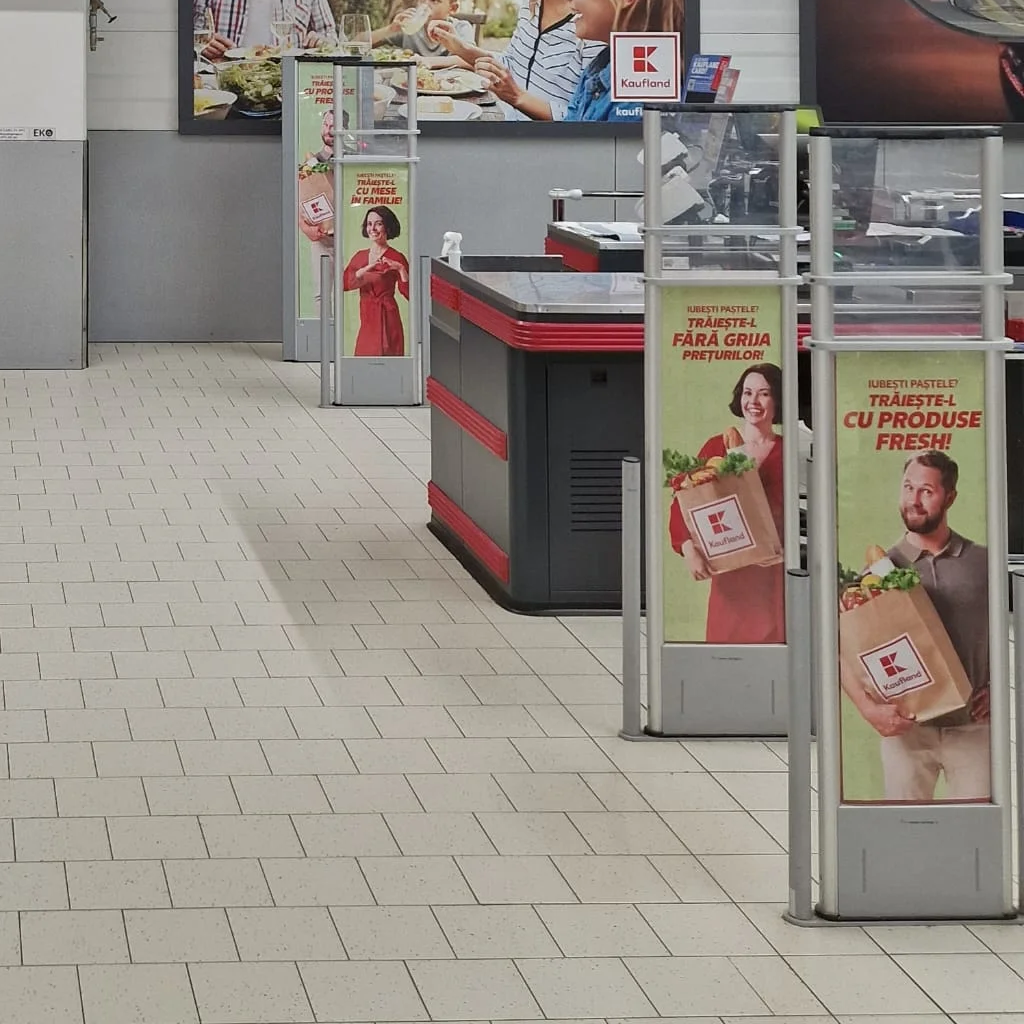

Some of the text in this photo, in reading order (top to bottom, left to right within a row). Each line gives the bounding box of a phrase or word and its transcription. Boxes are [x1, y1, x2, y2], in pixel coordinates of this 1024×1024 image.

[621, 78, 671, 88] Kaufland
[316, 88, 356, 96] PROSE
[356, 187, 397, 195] CU MESE
[363, 196, 403, 205] FAMILIE!
[687, 305, 760, 314] IUBEȘTI PAȘTELE?
[687, 316, 757, 331] TRĂIEȘTE-L
[672, 330, 771, 347] FĂRĂ GRIJA
[682, 350, 765, 363] PREȚURILOR!
[868, 379, 959, 391] IUBEȘTI PAȘTELE?
[869, 391, 957, 410] TRĂIEȘTE-L
[843, 411, 983, 429] CU PRODUSE
[875, 433, 953, 451] FRESH!
[708, 532, 745, 549] Kaufland
[883, 671, 922, 691] Kaufland
